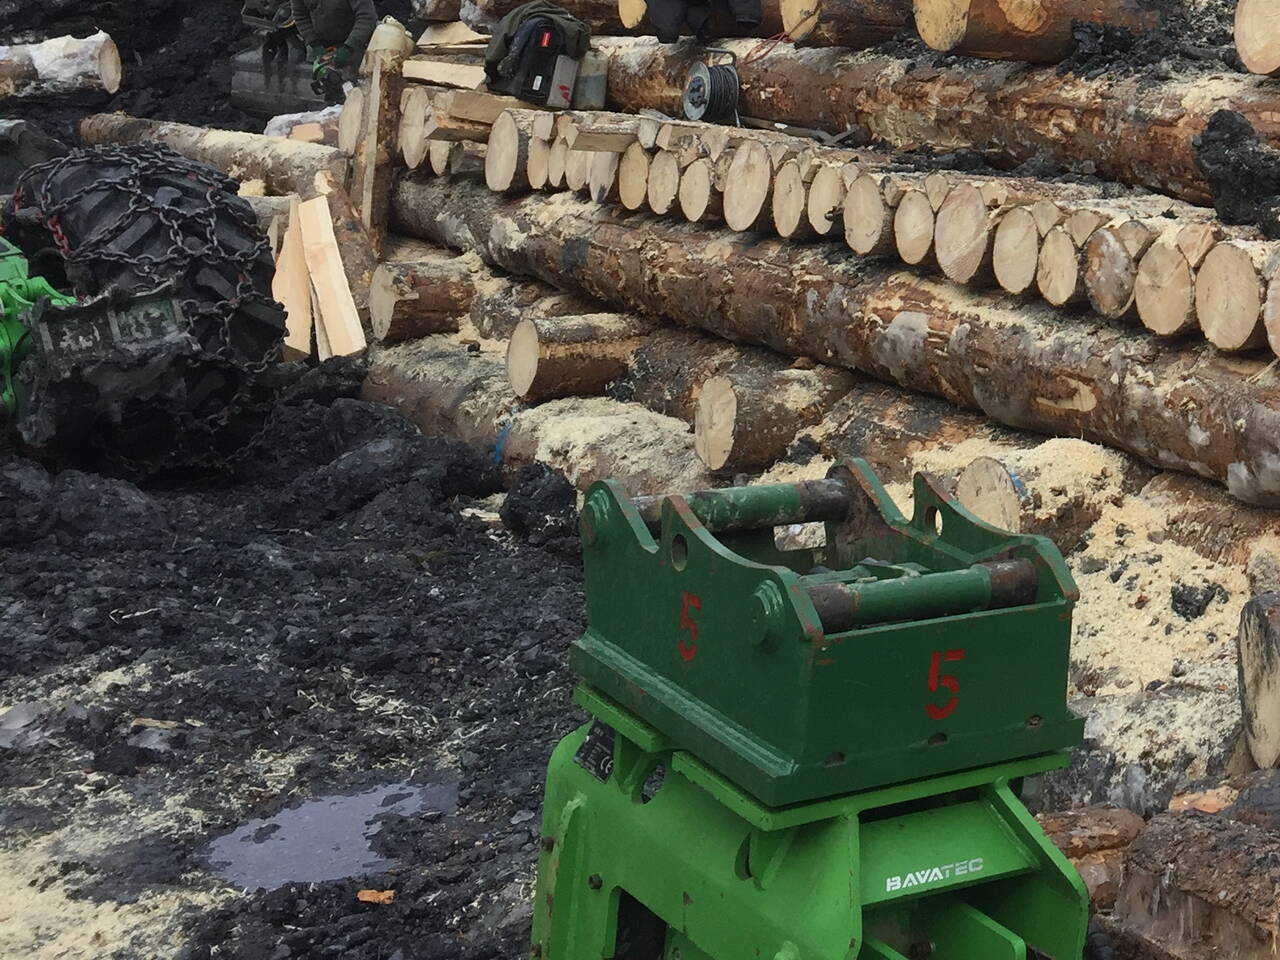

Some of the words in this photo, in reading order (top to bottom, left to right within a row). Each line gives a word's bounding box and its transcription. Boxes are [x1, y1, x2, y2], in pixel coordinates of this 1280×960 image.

[678, 591, 701, 662] 5
[924, 648, 965, 720] 5
[886, 857, 984, 892] BAVATEC
